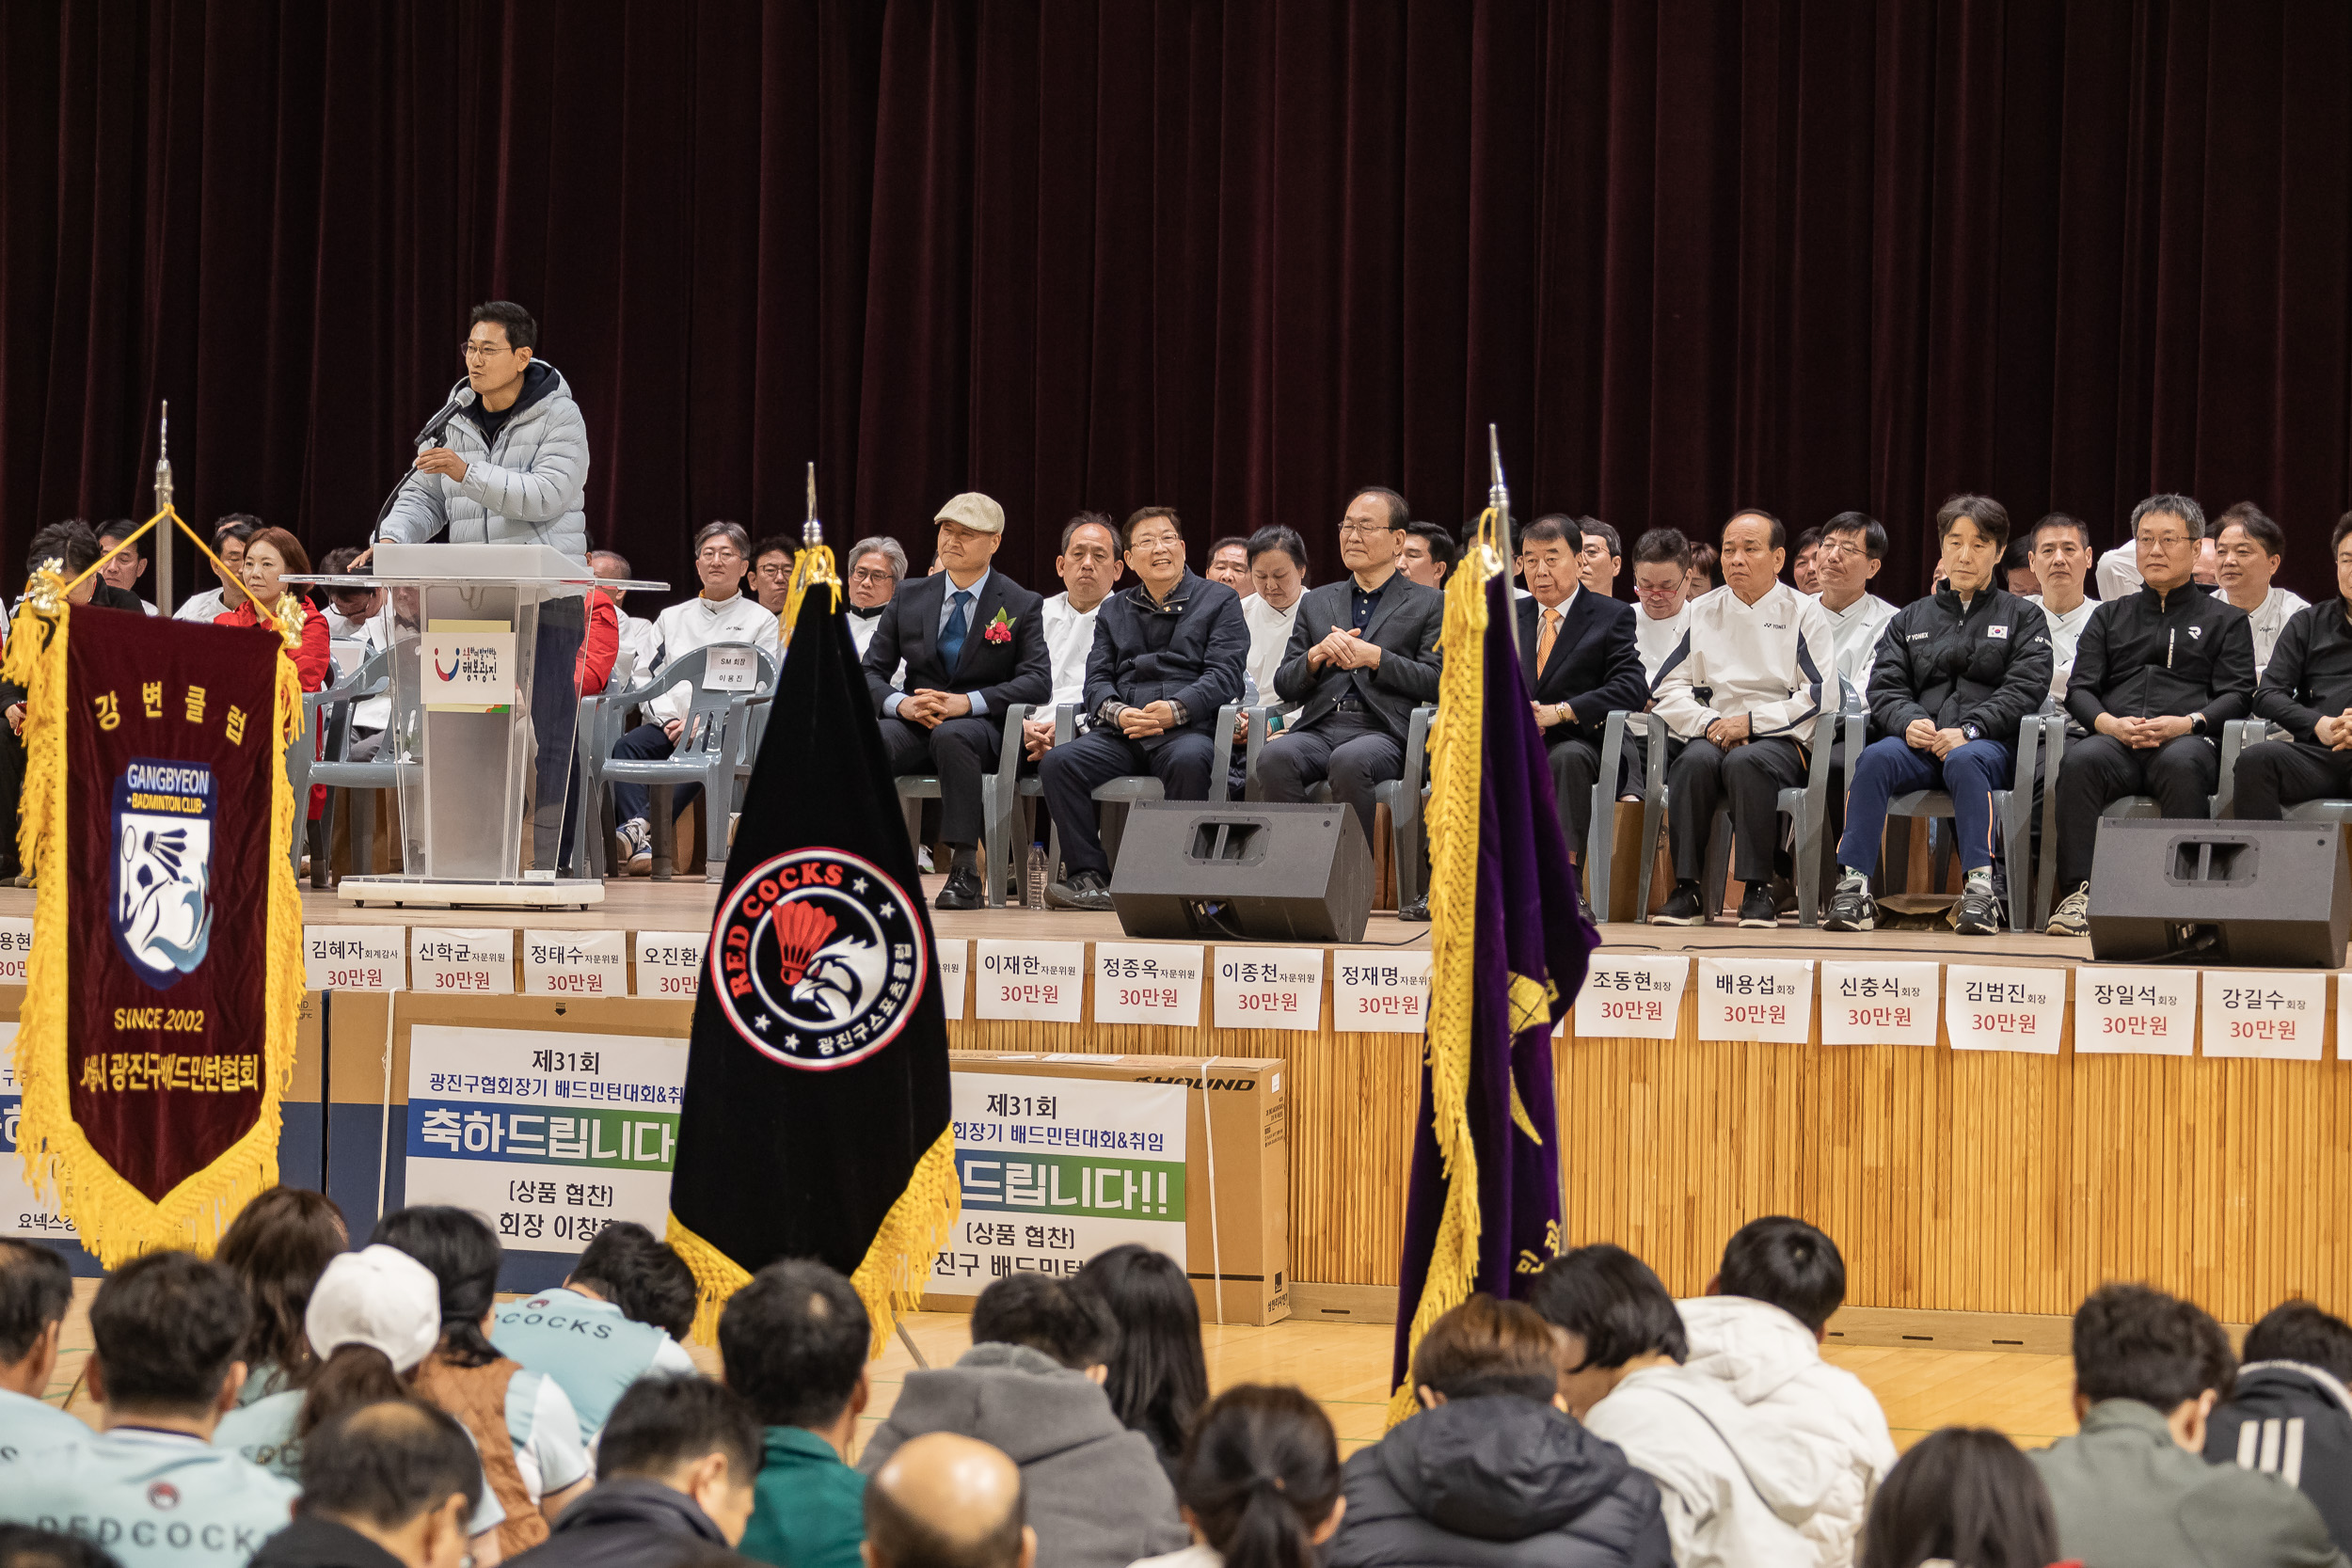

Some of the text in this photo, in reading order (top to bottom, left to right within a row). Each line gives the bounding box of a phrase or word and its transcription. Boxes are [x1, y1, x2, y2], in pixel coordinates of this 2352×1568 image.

[1912, 632, 1929, 641] YONEX
[127, 763, 210, 796] GANGBYEON
[132, 793, 202, 815] BADMINTON CLUB
[725, 862, 845, 999] RED COCKS
[312, 941, 364, 958] 김혜자
[420, 943, 470, 961] 신학균
[532, 946, 583, 964] 정태수
[644, 948, 697, 966] 오진환
[983, 956, 1041, 976] 이재한
[1103, 958, 1159, 979] 정종옥
[1222, 961, 1278, 983] 이종천
[1342, 966, 1398, 986] 정재명
[327, 969, 382, 987] 30만원
[436, 972, 490, 990] 30만원
[548, 974, 602, 991] 30만원
[1594, 972, 1650, 990] 조동현
[1717, 974, 1773, 994] 배용섭
[1840, 977, 1898, 997] 신충식
[1001, 985, 1057, 1004] 30만원
[1120, 989, 1177, 1007] 30만원
[1239, 993, 1296, 1011] 30만원
[1966, 982, 2024, 1003] 김범진
[2095, 985, 2154, 1006] 장일석
[2223, 990, 2284, 1009] 강길수
[1359, 996, 1418, 1014] 30만원
[1602, 1001, 1661, 1020] 30만원
[1724, 1006, 1785, 1023] 30만원
[114, 1008, 204, 1032] SINCE 2002
[1849, 1007, 1911, 1026] 30만원
[1973, 1014, 2035, 1034] 30만원
[2104, 1016, 2166, 1036] 30만원
[2231, 1021, 2295, 1039] 30만원
[532, 1050, 599, 1074] 제31회
[429, 1074, 548, 1098] 광진구협회장기
[987, 1094, 1056, 1119] 제31회
[421, 1108, 675, 1164] 축하드립니다
[1010, 1126, 1164, 1153] 배드민턴대회&취임
[499, 1212, 545, 1238] 회장
